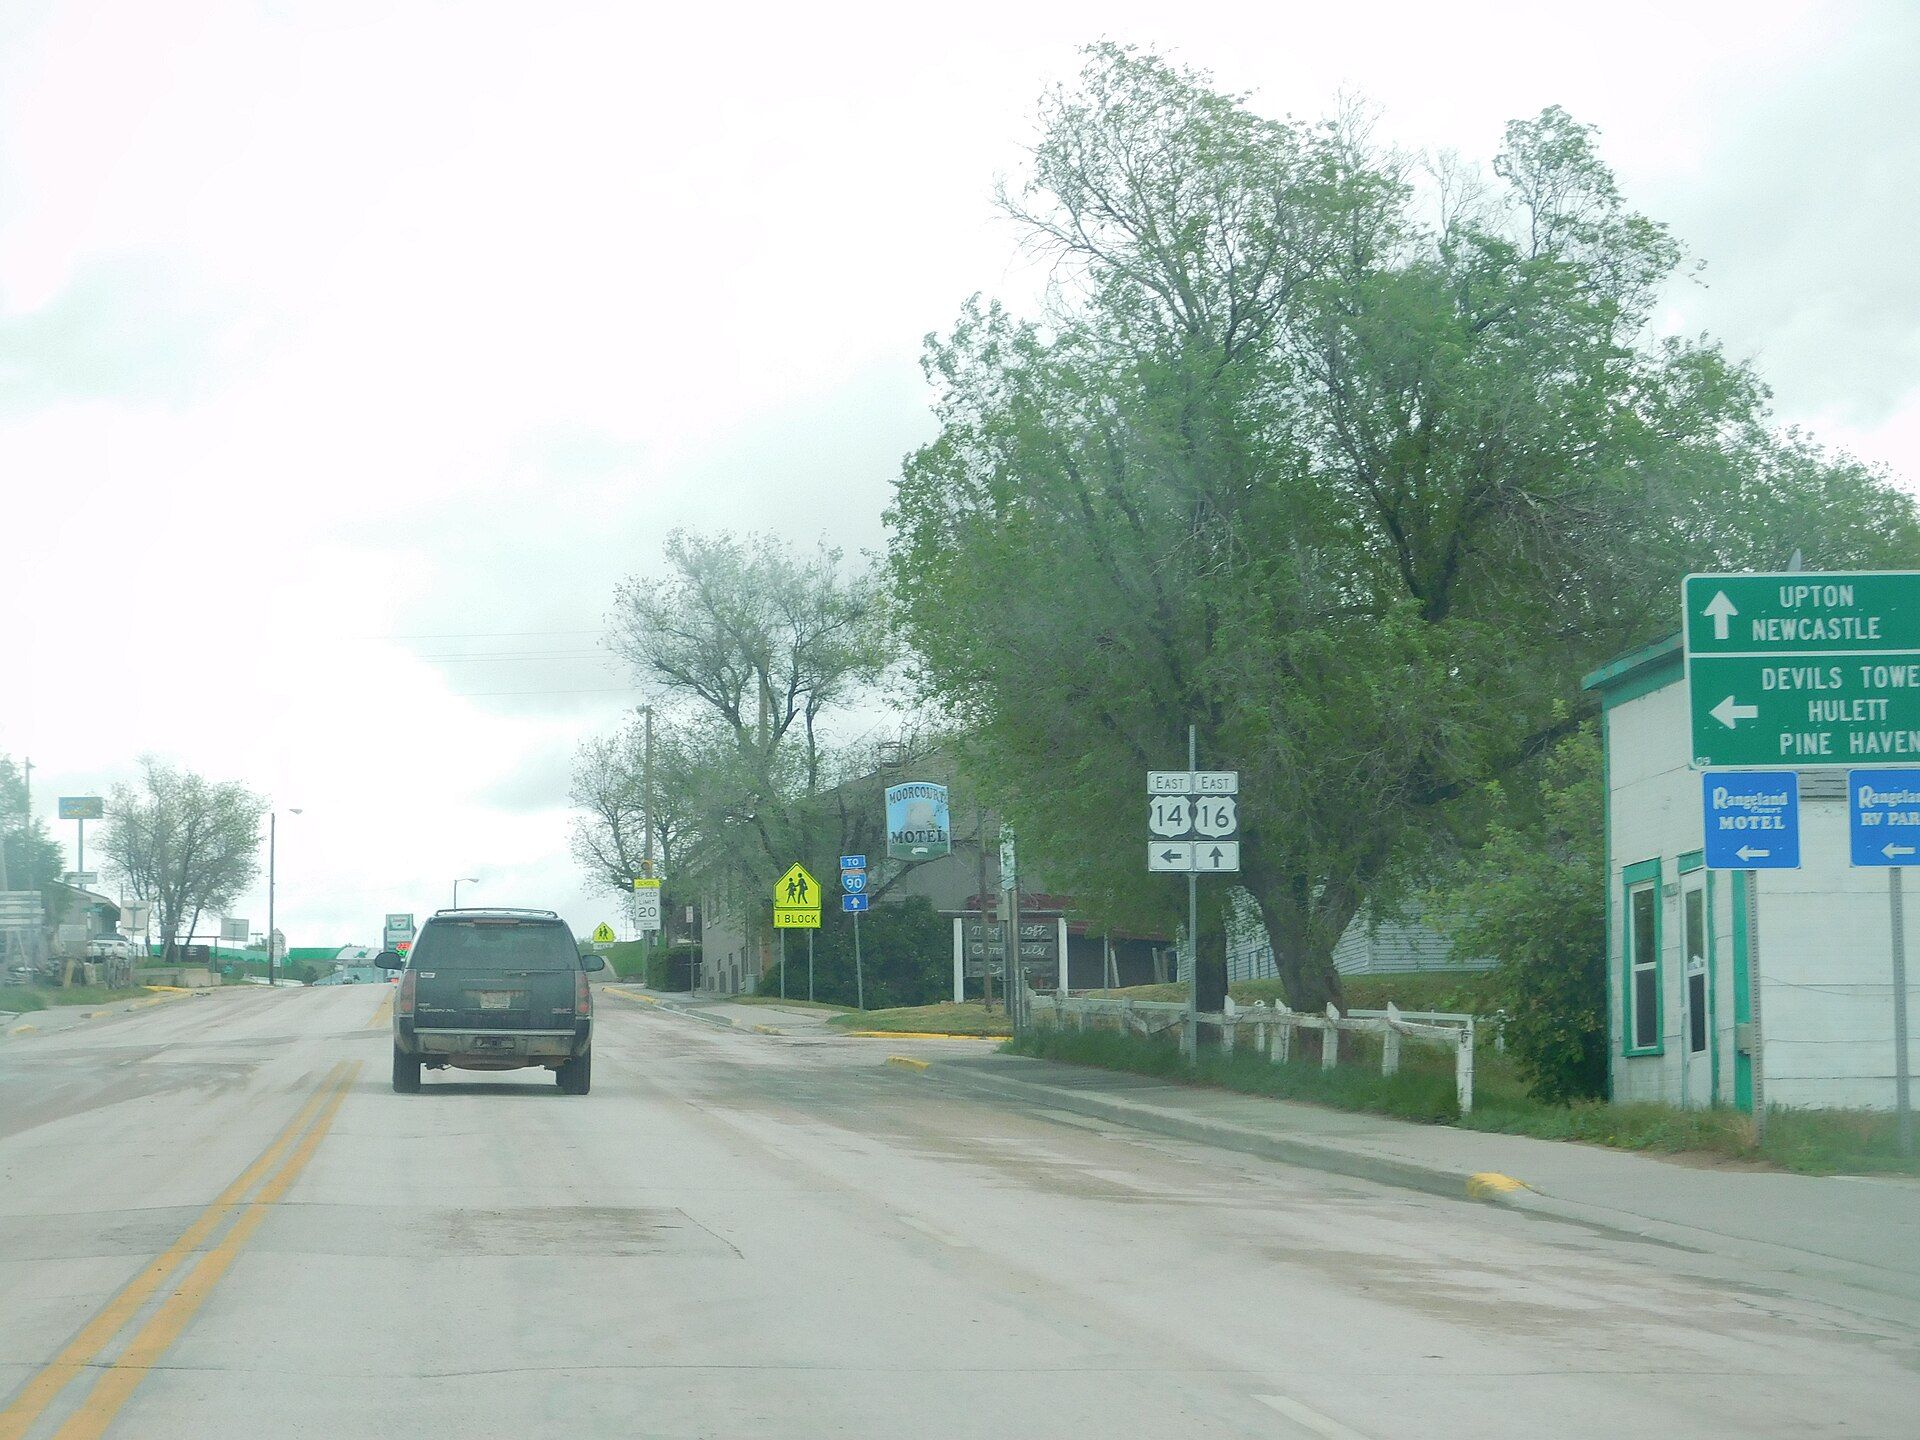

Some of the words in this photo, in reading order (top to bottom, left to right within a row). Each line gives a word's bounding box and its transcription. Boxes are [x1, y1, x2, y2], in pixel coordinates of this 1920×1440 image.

[1779, 584, 1854, 608] UPTON
[1752, 616, 1882, 641] NEWCASTLE
[1761, 666, 1843, 690] DEVILS
[1859, 665, 1920, 689] TOWE
[1808, 699, 1889, 722] HULETT
[1779, 732, 1832, 756] PINE
[1850, 730, 1920, 754] HAVEN
[1713, 786, 1788, 810] Rangeland
[1157, 805, 1183, 827] 14
[1202, 805, 1230, 828] 16
[1719, 815, 1786, 830] MOTEL
[1860, 812, 1883, 826] RV
[890, 829, 946, 844] MOTEL
[846, 858, 859, 866] TO
[846, 878, 863, 889] 90
[638, 906, 657, 918] 20
[784, 914, 817, 923] BLOCK
